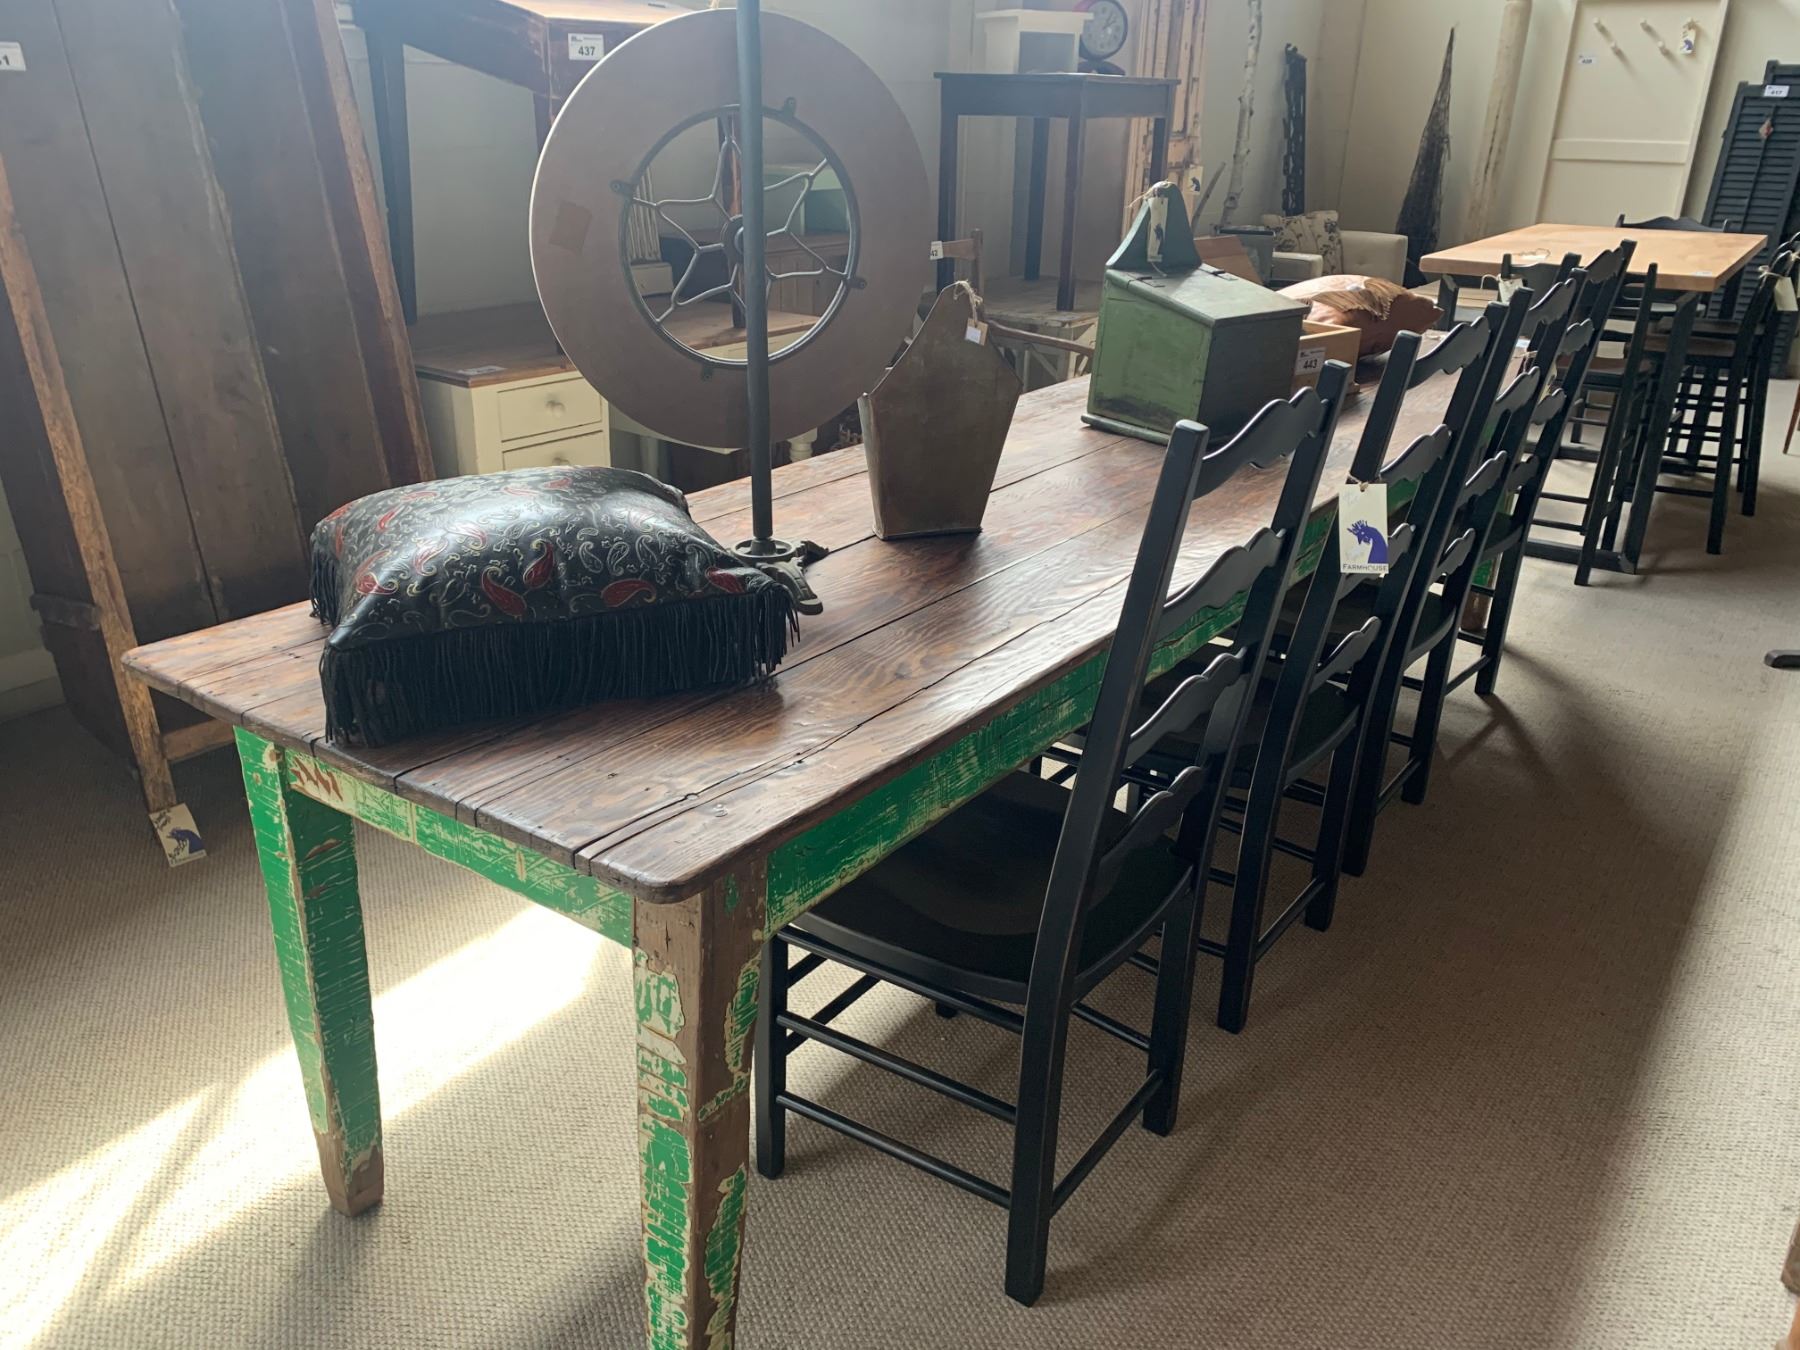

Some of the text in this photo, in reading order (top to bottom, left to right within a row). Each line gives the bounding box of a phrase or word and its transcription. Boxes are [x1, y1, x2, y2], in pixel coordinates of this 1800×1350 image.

[578, 46, 595, 56] 437
[1303, 358, 1318, 369] 443
[1342, 563, 1388, 572] FARMHOUSE
